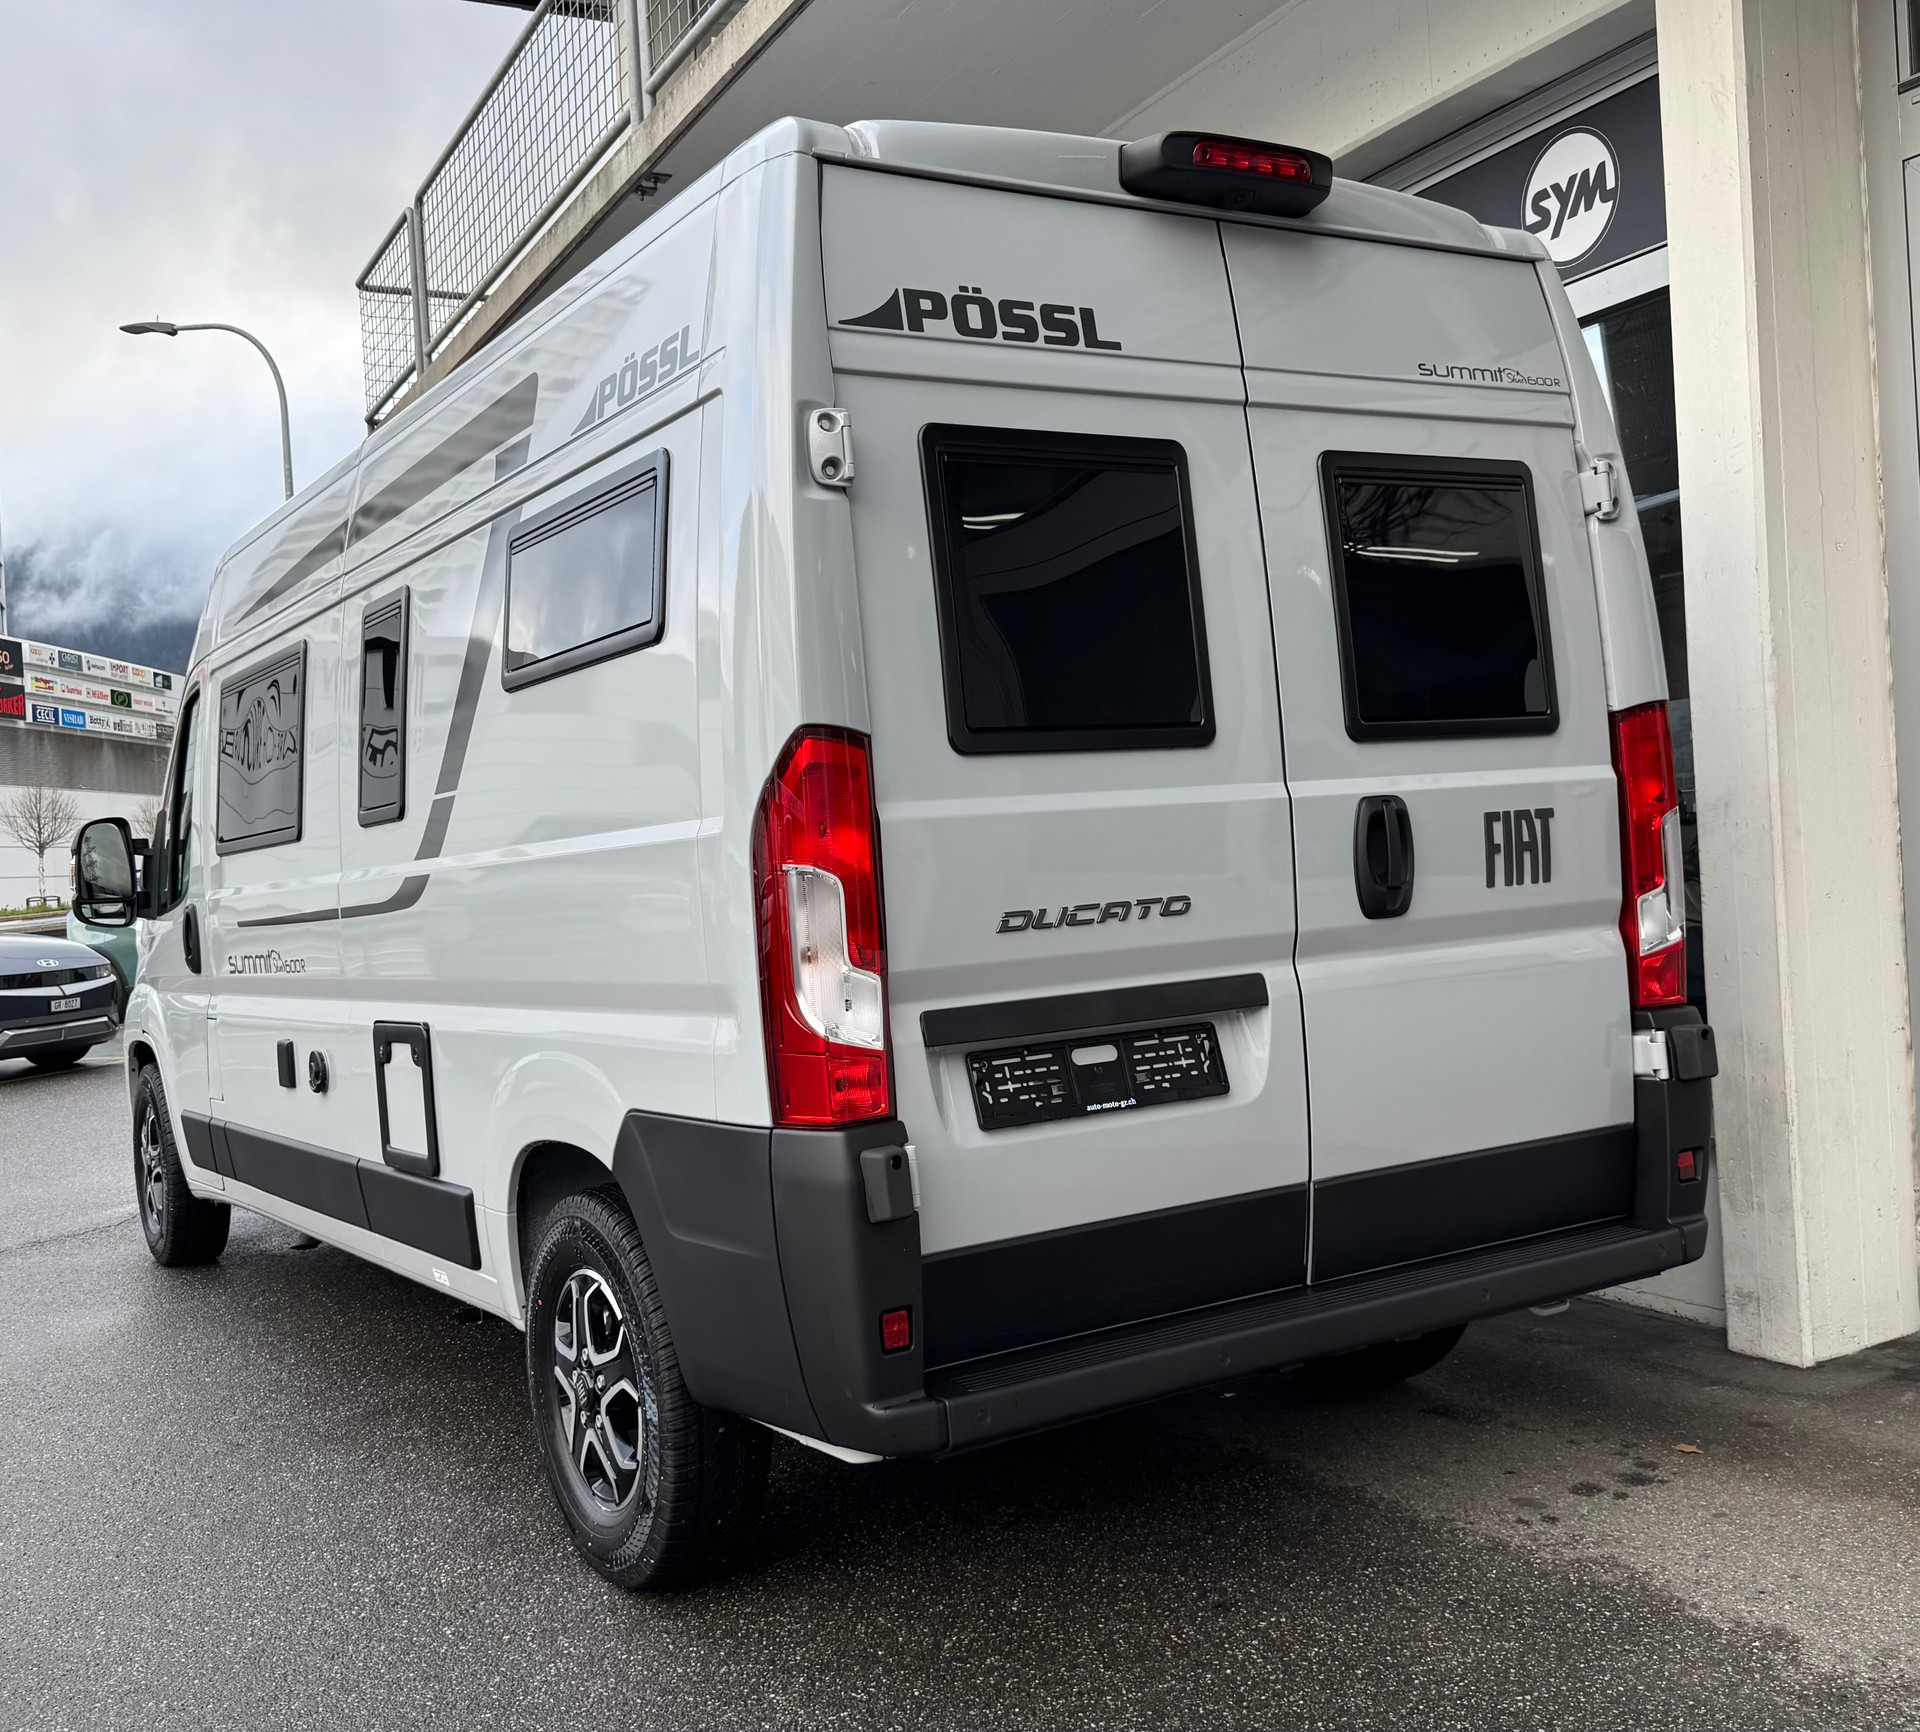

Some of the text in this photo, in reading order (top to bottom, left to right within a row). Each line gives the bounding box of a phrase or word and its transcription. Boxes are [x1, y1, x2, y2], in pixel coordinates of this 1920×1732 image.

[1527, 160, 1615, 240] SYM
[902, 285, 1122, 351] PÖSSL
[597, 324, 700, 421] PÖSSL
[36, 709, 55, 720] CECIL
[91, 689, 109, 701] Müller
[1483, 807, 1554, 888] FIAT
[996, 895, 1191, 933] DUCATO
